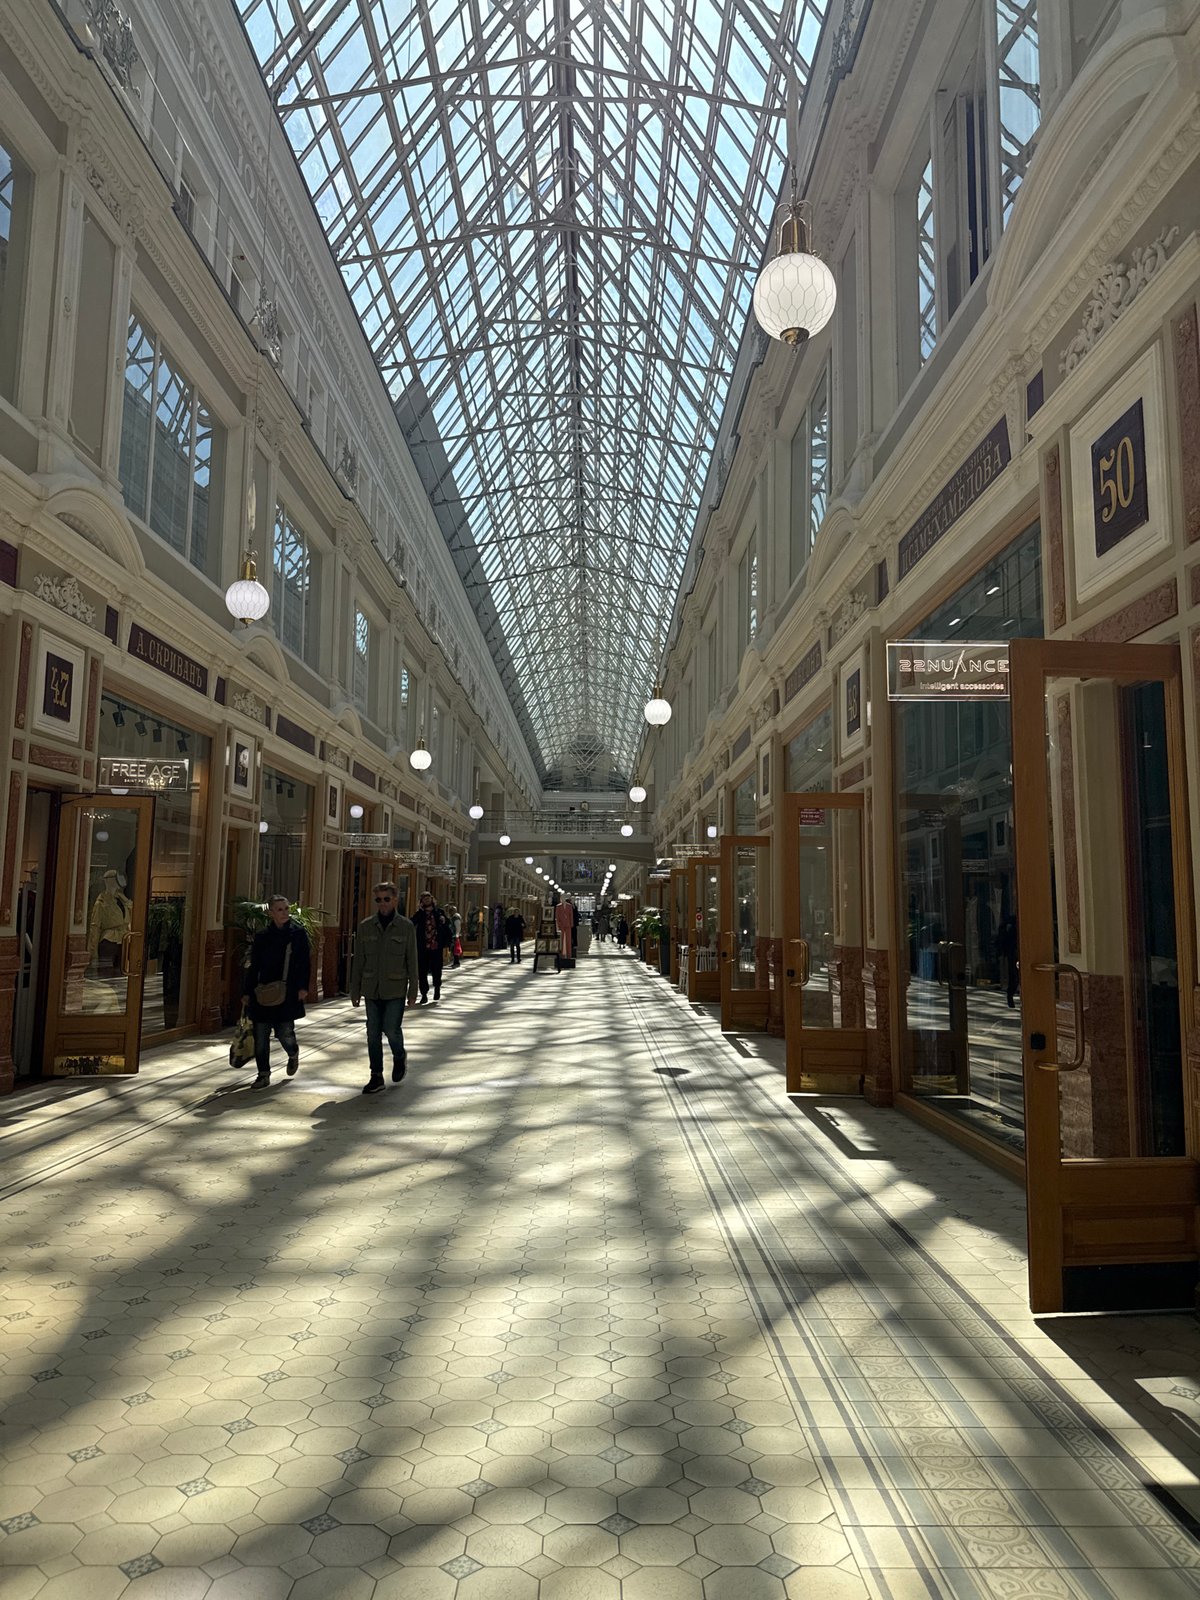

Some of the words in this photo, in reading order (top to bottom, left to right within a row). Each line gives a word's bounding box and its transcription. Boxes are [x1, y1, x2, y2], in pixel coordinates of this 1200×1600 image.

[1100, 436, 1134, 523] 50
[149, 639, 202, 688] СКРИВАНЪ
[50, 666, 69, 707] 47
[960, 682, 1005, 690] accessories
[111, 763, 147, 777] FREE
[149, 765, 181, 779] AGE
